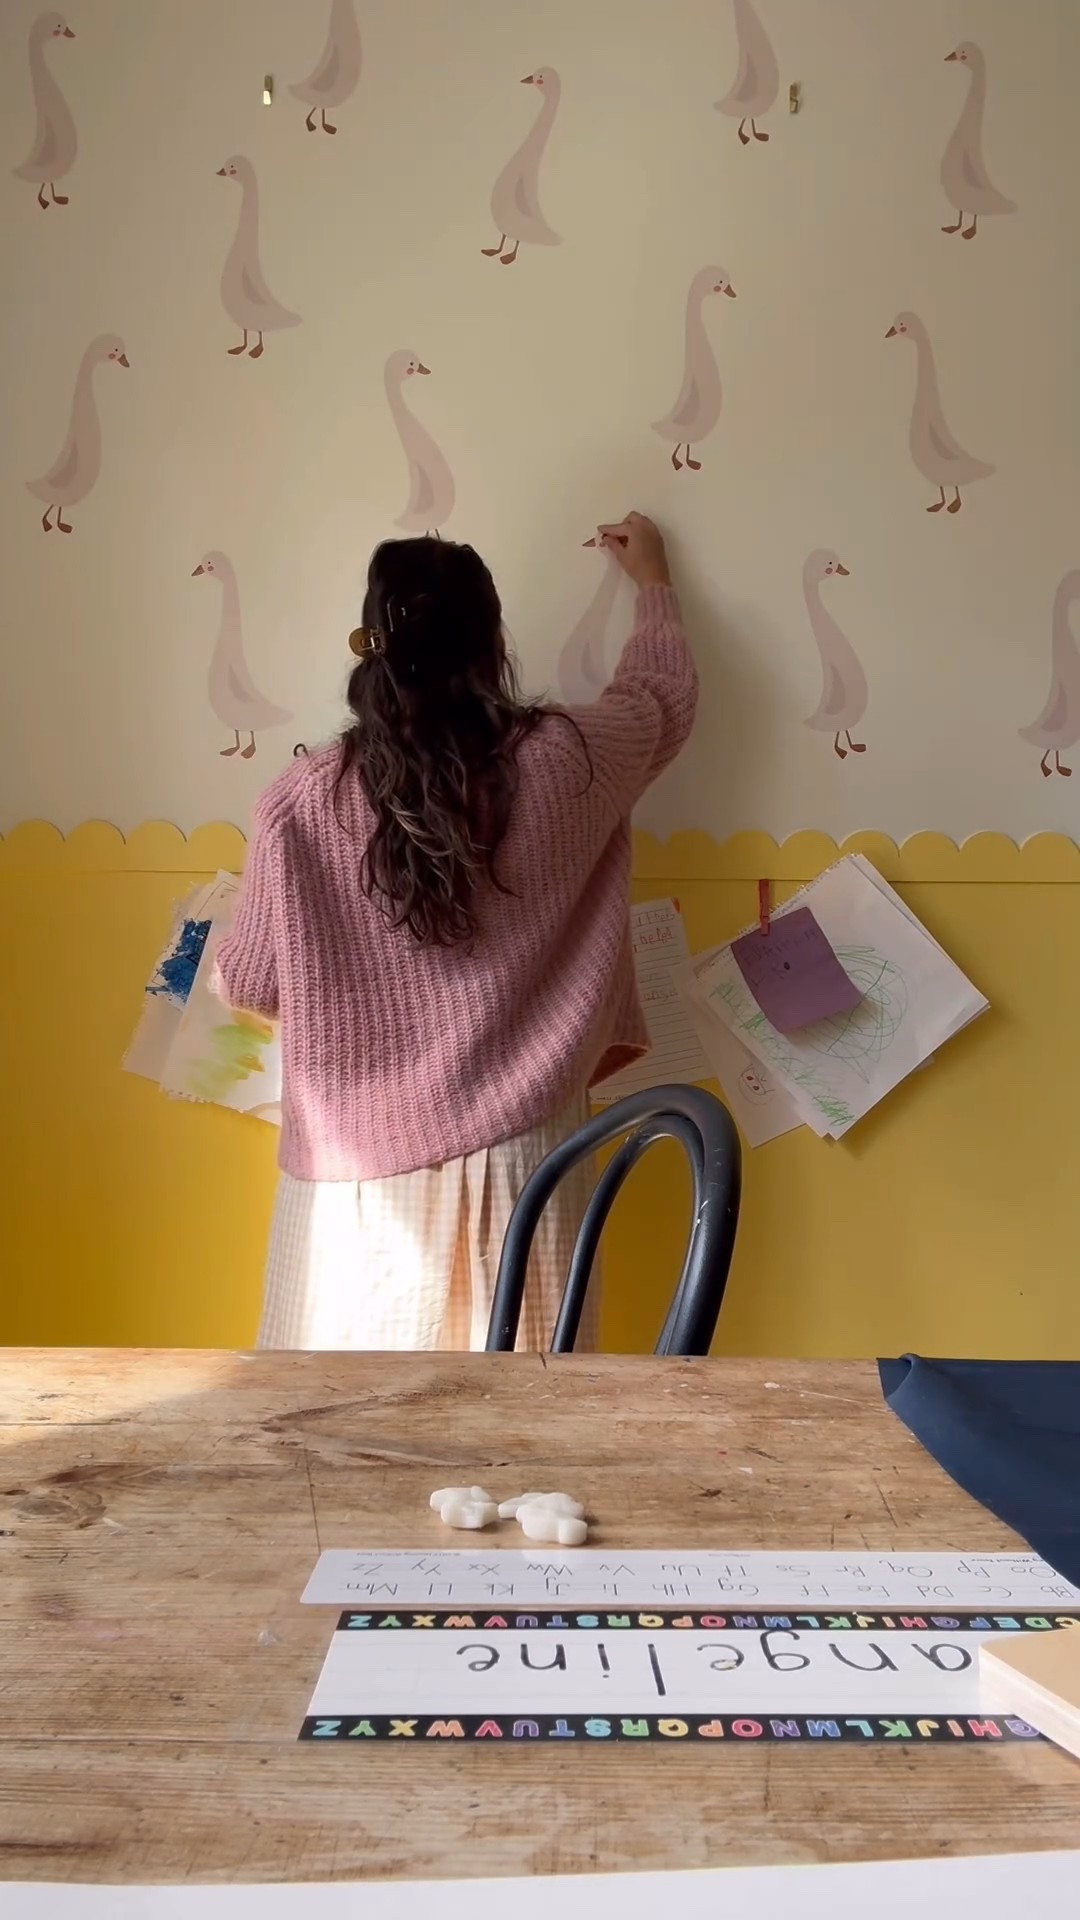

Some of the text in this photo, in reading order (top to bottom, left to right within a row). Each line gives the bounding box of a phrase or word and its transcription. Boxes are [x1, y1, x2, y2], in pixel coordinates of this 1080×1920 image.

[352, 1563, 384, 1576] Zz
[411, 1558, 441, 1576] Yy
[468, 1563, 500, 1576] Xx
[527, 1563, 573, 1576] Ww
[600, 1564, 635, 1576] Vv
[662, 1564, 702, 1577] Uu
[775, 1564, 811, 1578] Ss
[836, 1565, 867, 1578] Rr
[879, 1560, 933, 1578] Qq
[957, 1560, 991, 1578] Pp
[1010, 1566, 1057, 1579] Oo
[347, 1583, 398, 1596] Mm
[485, 1583, 515, 1596] Kk
[545, 1576, 570, 1596] Jj
[652, 1583, 691, 1596] Hh
[717, 1577, 759, 1597] Gg
[800, 1584, 830, 1597] Ff
[857, 1584, 891, 1598] Ee
[916, 1585, 954, 1598] Dd
[977, 1585, 1012, 1598] Cc
[1040, 1585, 1075, 1598] Bb
